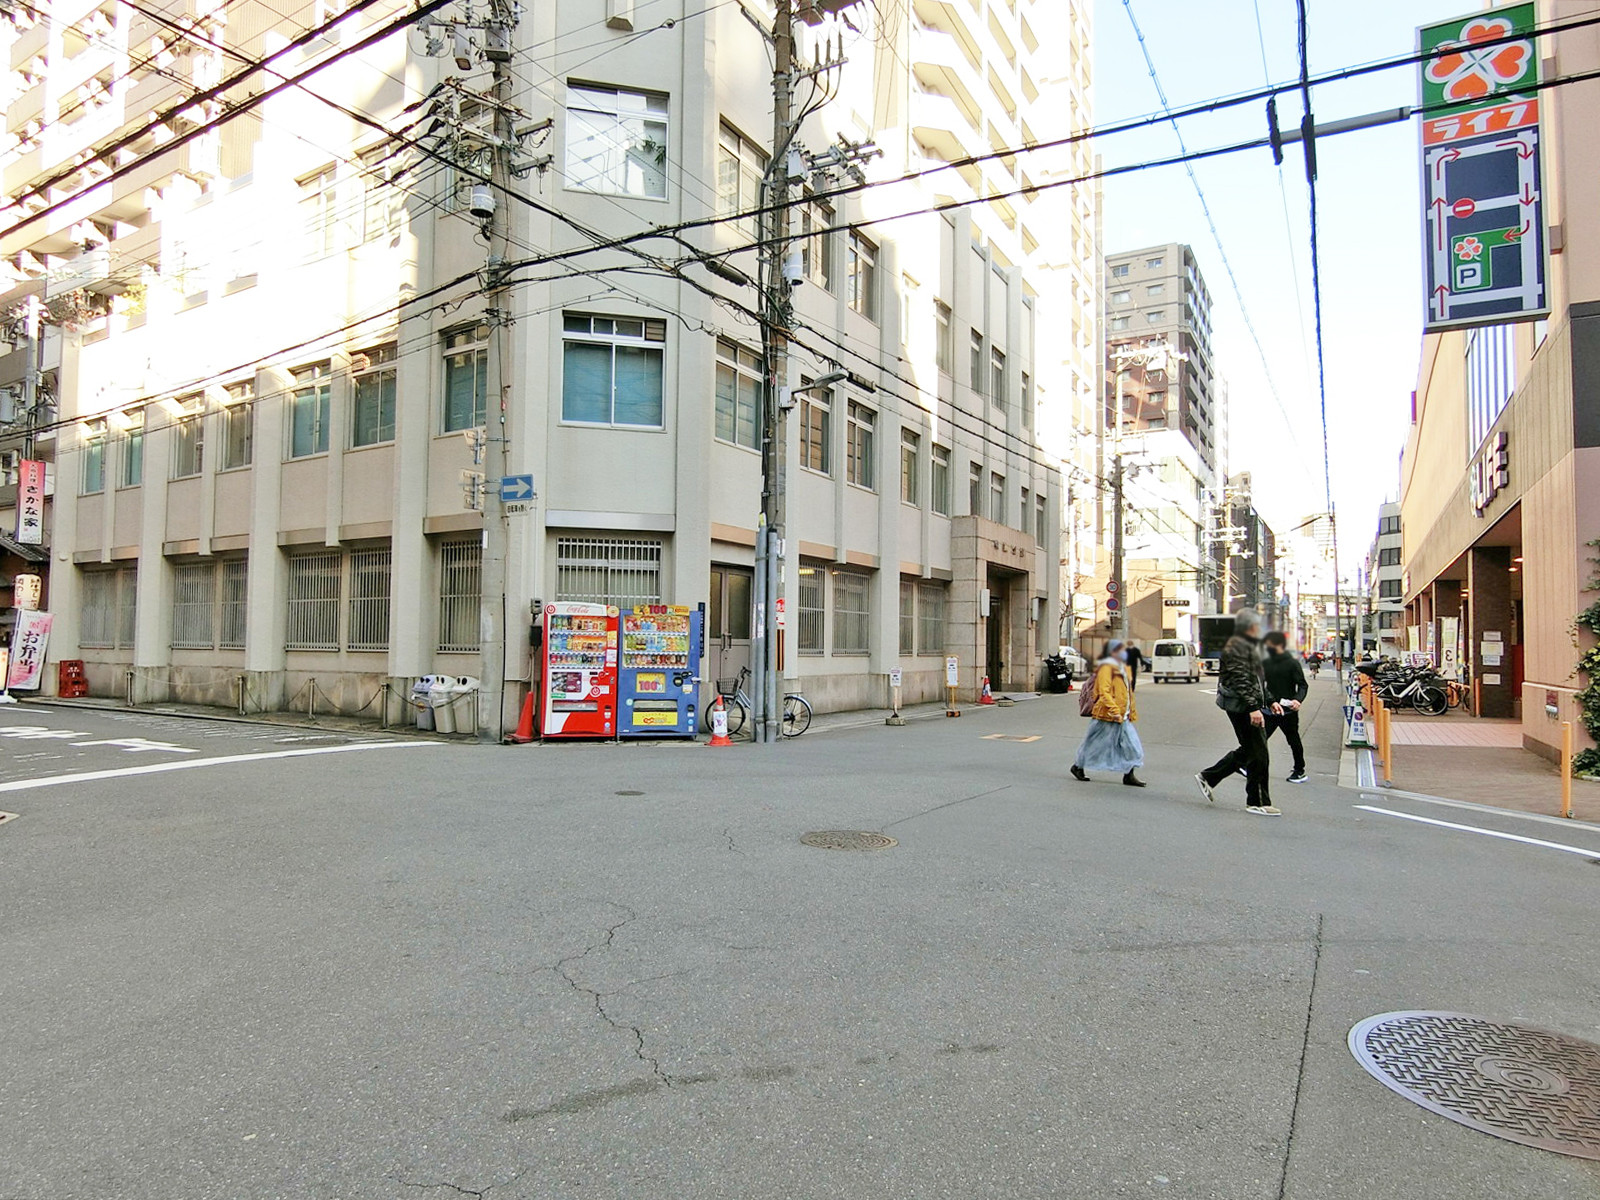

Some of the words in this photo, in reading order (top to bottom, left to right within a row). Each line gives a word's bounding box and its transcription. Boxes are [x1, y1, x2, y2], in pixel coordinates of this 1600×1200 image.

[1432, 104, 1527, 140] ライフ
[1460, 268, 1477, 284] P
[1476, 431, 1509, 519] LIFE
[24, 485, 39, 527] さかな家
[19, 631, 40, 675] お弁当
